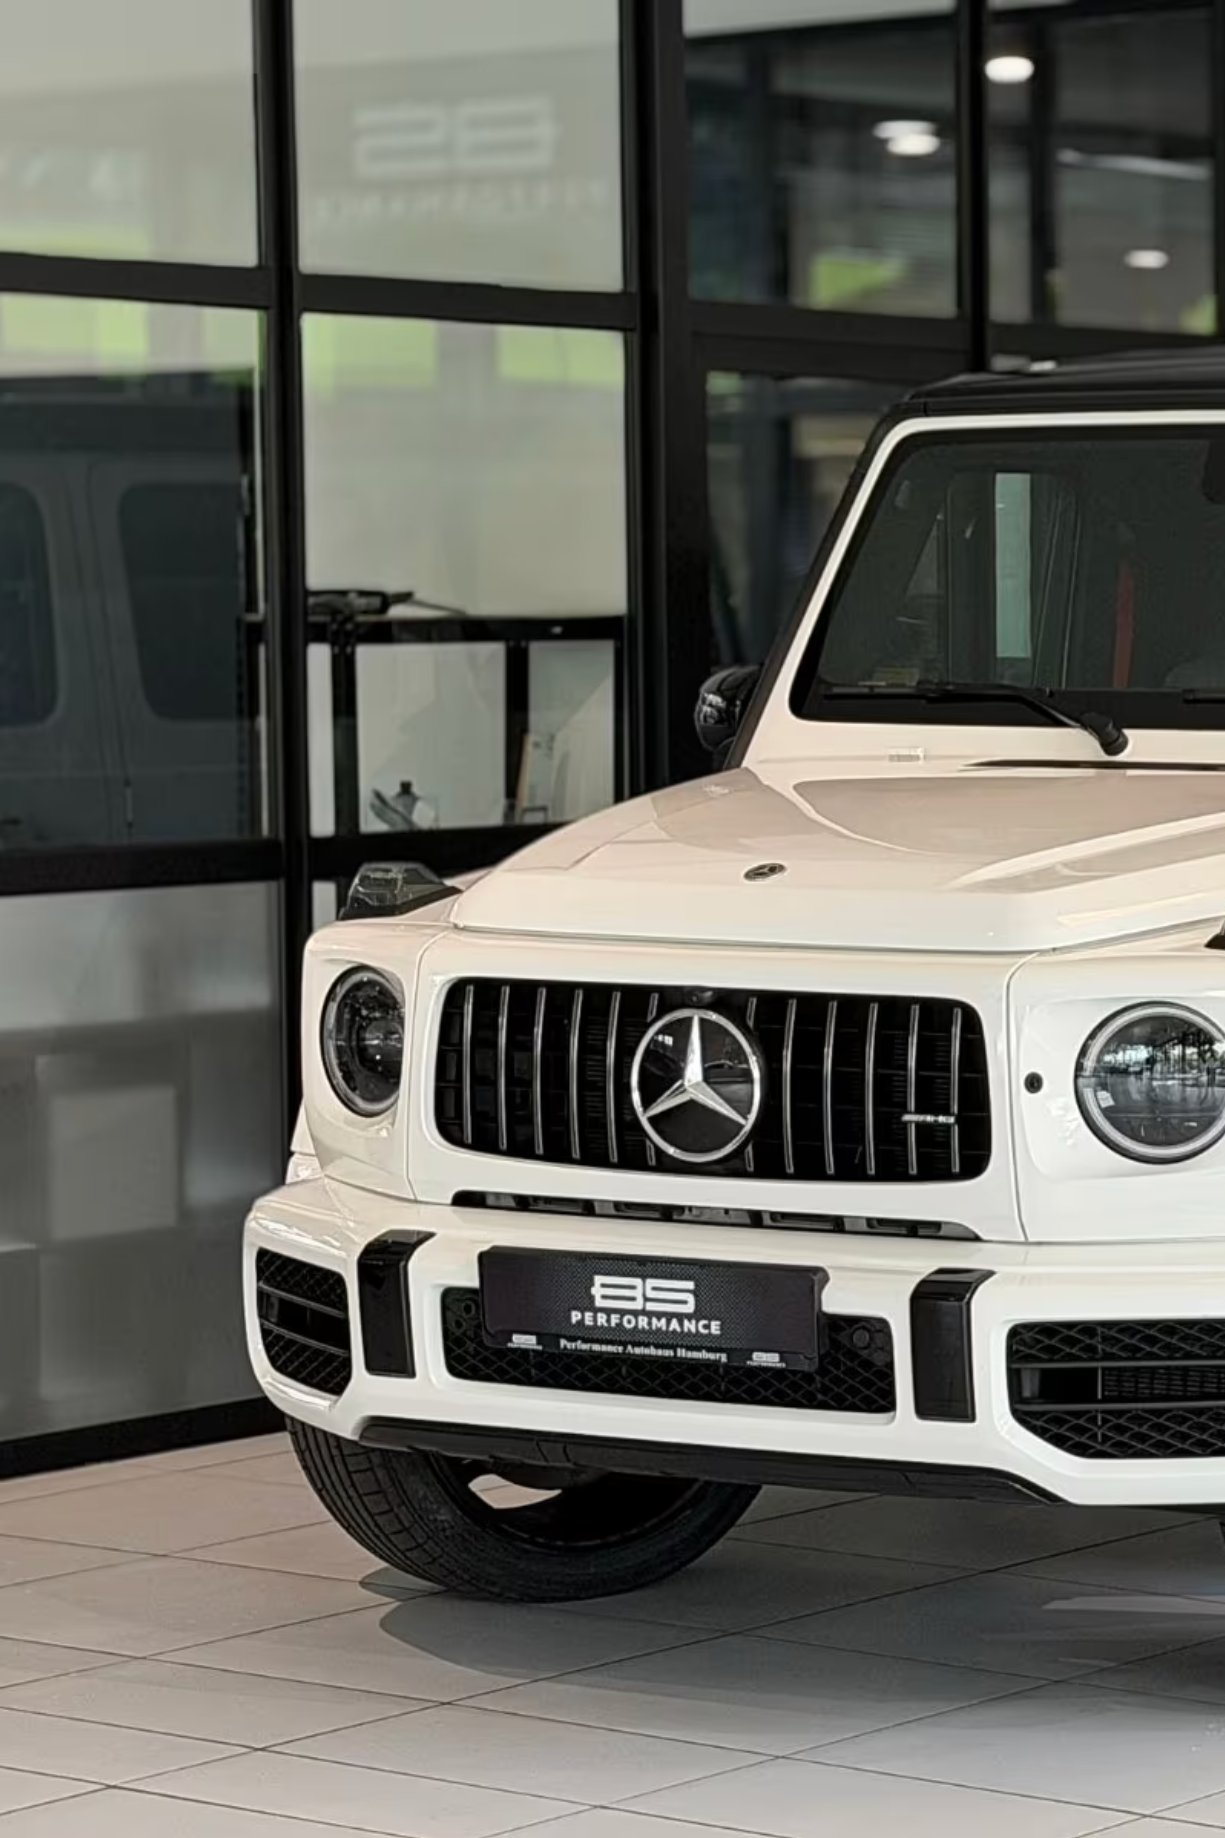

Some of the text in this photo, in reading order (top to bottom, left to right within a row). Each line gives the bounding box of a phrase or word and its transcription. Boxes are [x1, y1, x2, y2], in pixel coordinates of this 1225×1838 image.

[570, 1309, 722, 1335] PERFORMANCE
[559, 1338, 623, 1354] Performance
[625, 1343, 675, 1357] Autohaus
[676, 1347, 728, 1364] Hamburg
